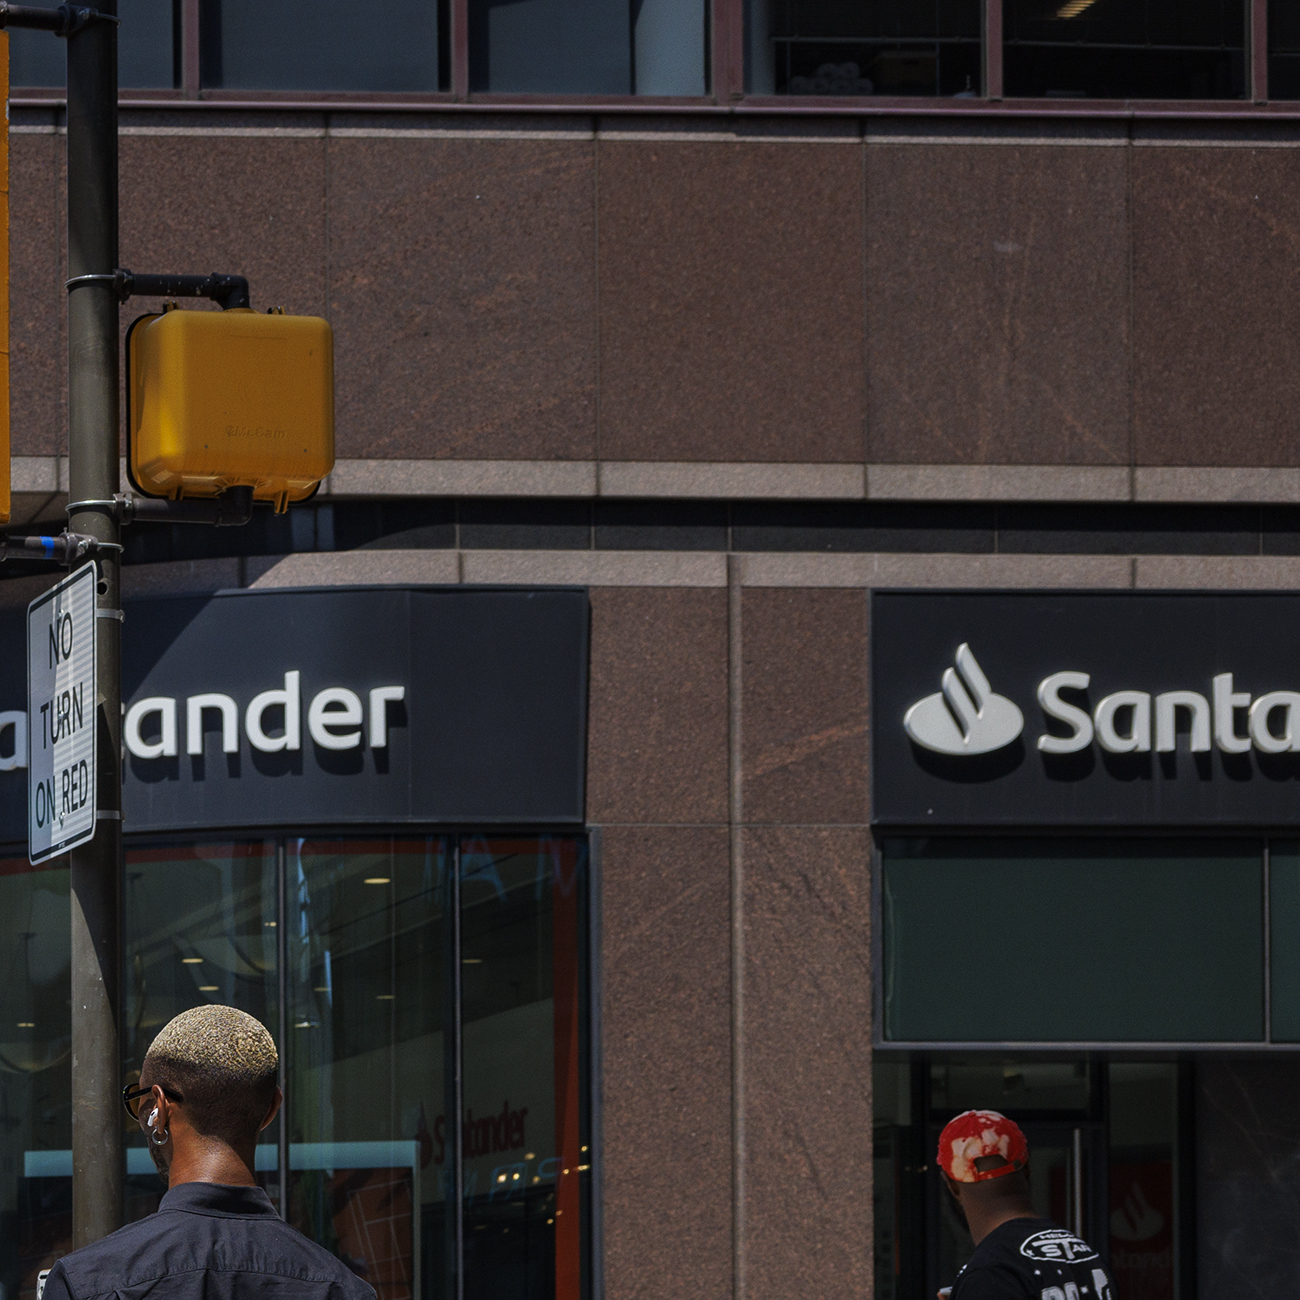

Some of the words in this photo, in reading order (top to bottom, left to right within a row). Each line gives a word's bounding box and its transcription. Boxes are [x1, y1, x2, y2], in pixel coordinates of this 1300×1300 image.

[49, 611, 73, 670] NO
[40, 681, 83, 749] TURN
[36, 776, 56, 829] ON
[62, 759, 88, 815] RED
[433, 1100, 529, 1165] Stander
